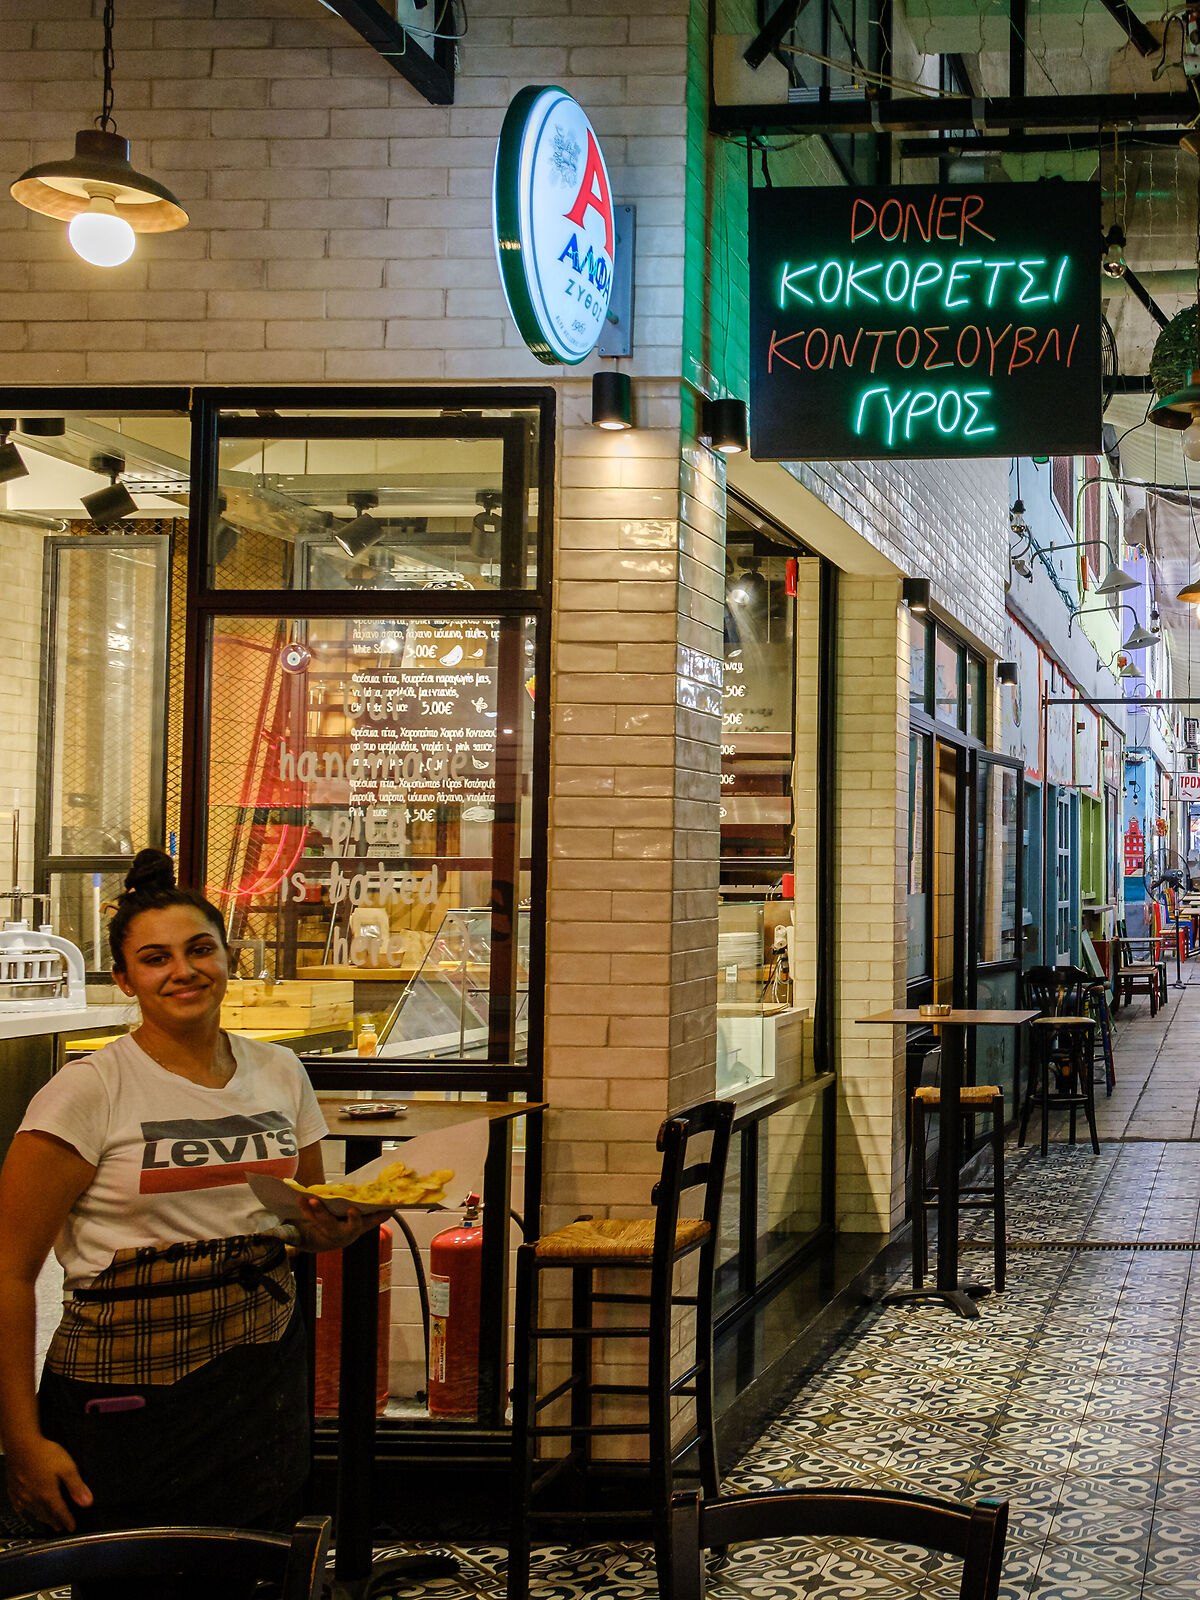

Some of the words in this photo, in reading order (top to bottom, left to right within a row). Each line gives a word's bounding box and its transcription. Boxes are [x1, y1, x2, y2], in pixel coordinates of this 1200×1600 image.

[851, 194, 996, 245] DONER
[778, 255, 1069, 309] ΚΟΚΟΡΕΤΣΙ
[768, 324, 1080, 377] ΚΟΝΤΟΣΟΥΒΛΙ
[856, 386, 996, 446] ΓΥΡΟΣ
[343, 682, 404, 721] Our
[386, 701, 409, 712] Suce
[421, 701, 455, 716] 5.00€
[279, 741, 469, 783] handmade
[331, 803, 412, 857] pita
[281, 868, 306, 903] is
[329, 860, 439, 907] baked
[333, 925, 404, 967] here
[142, 1128, 298, 1170] Levi's
